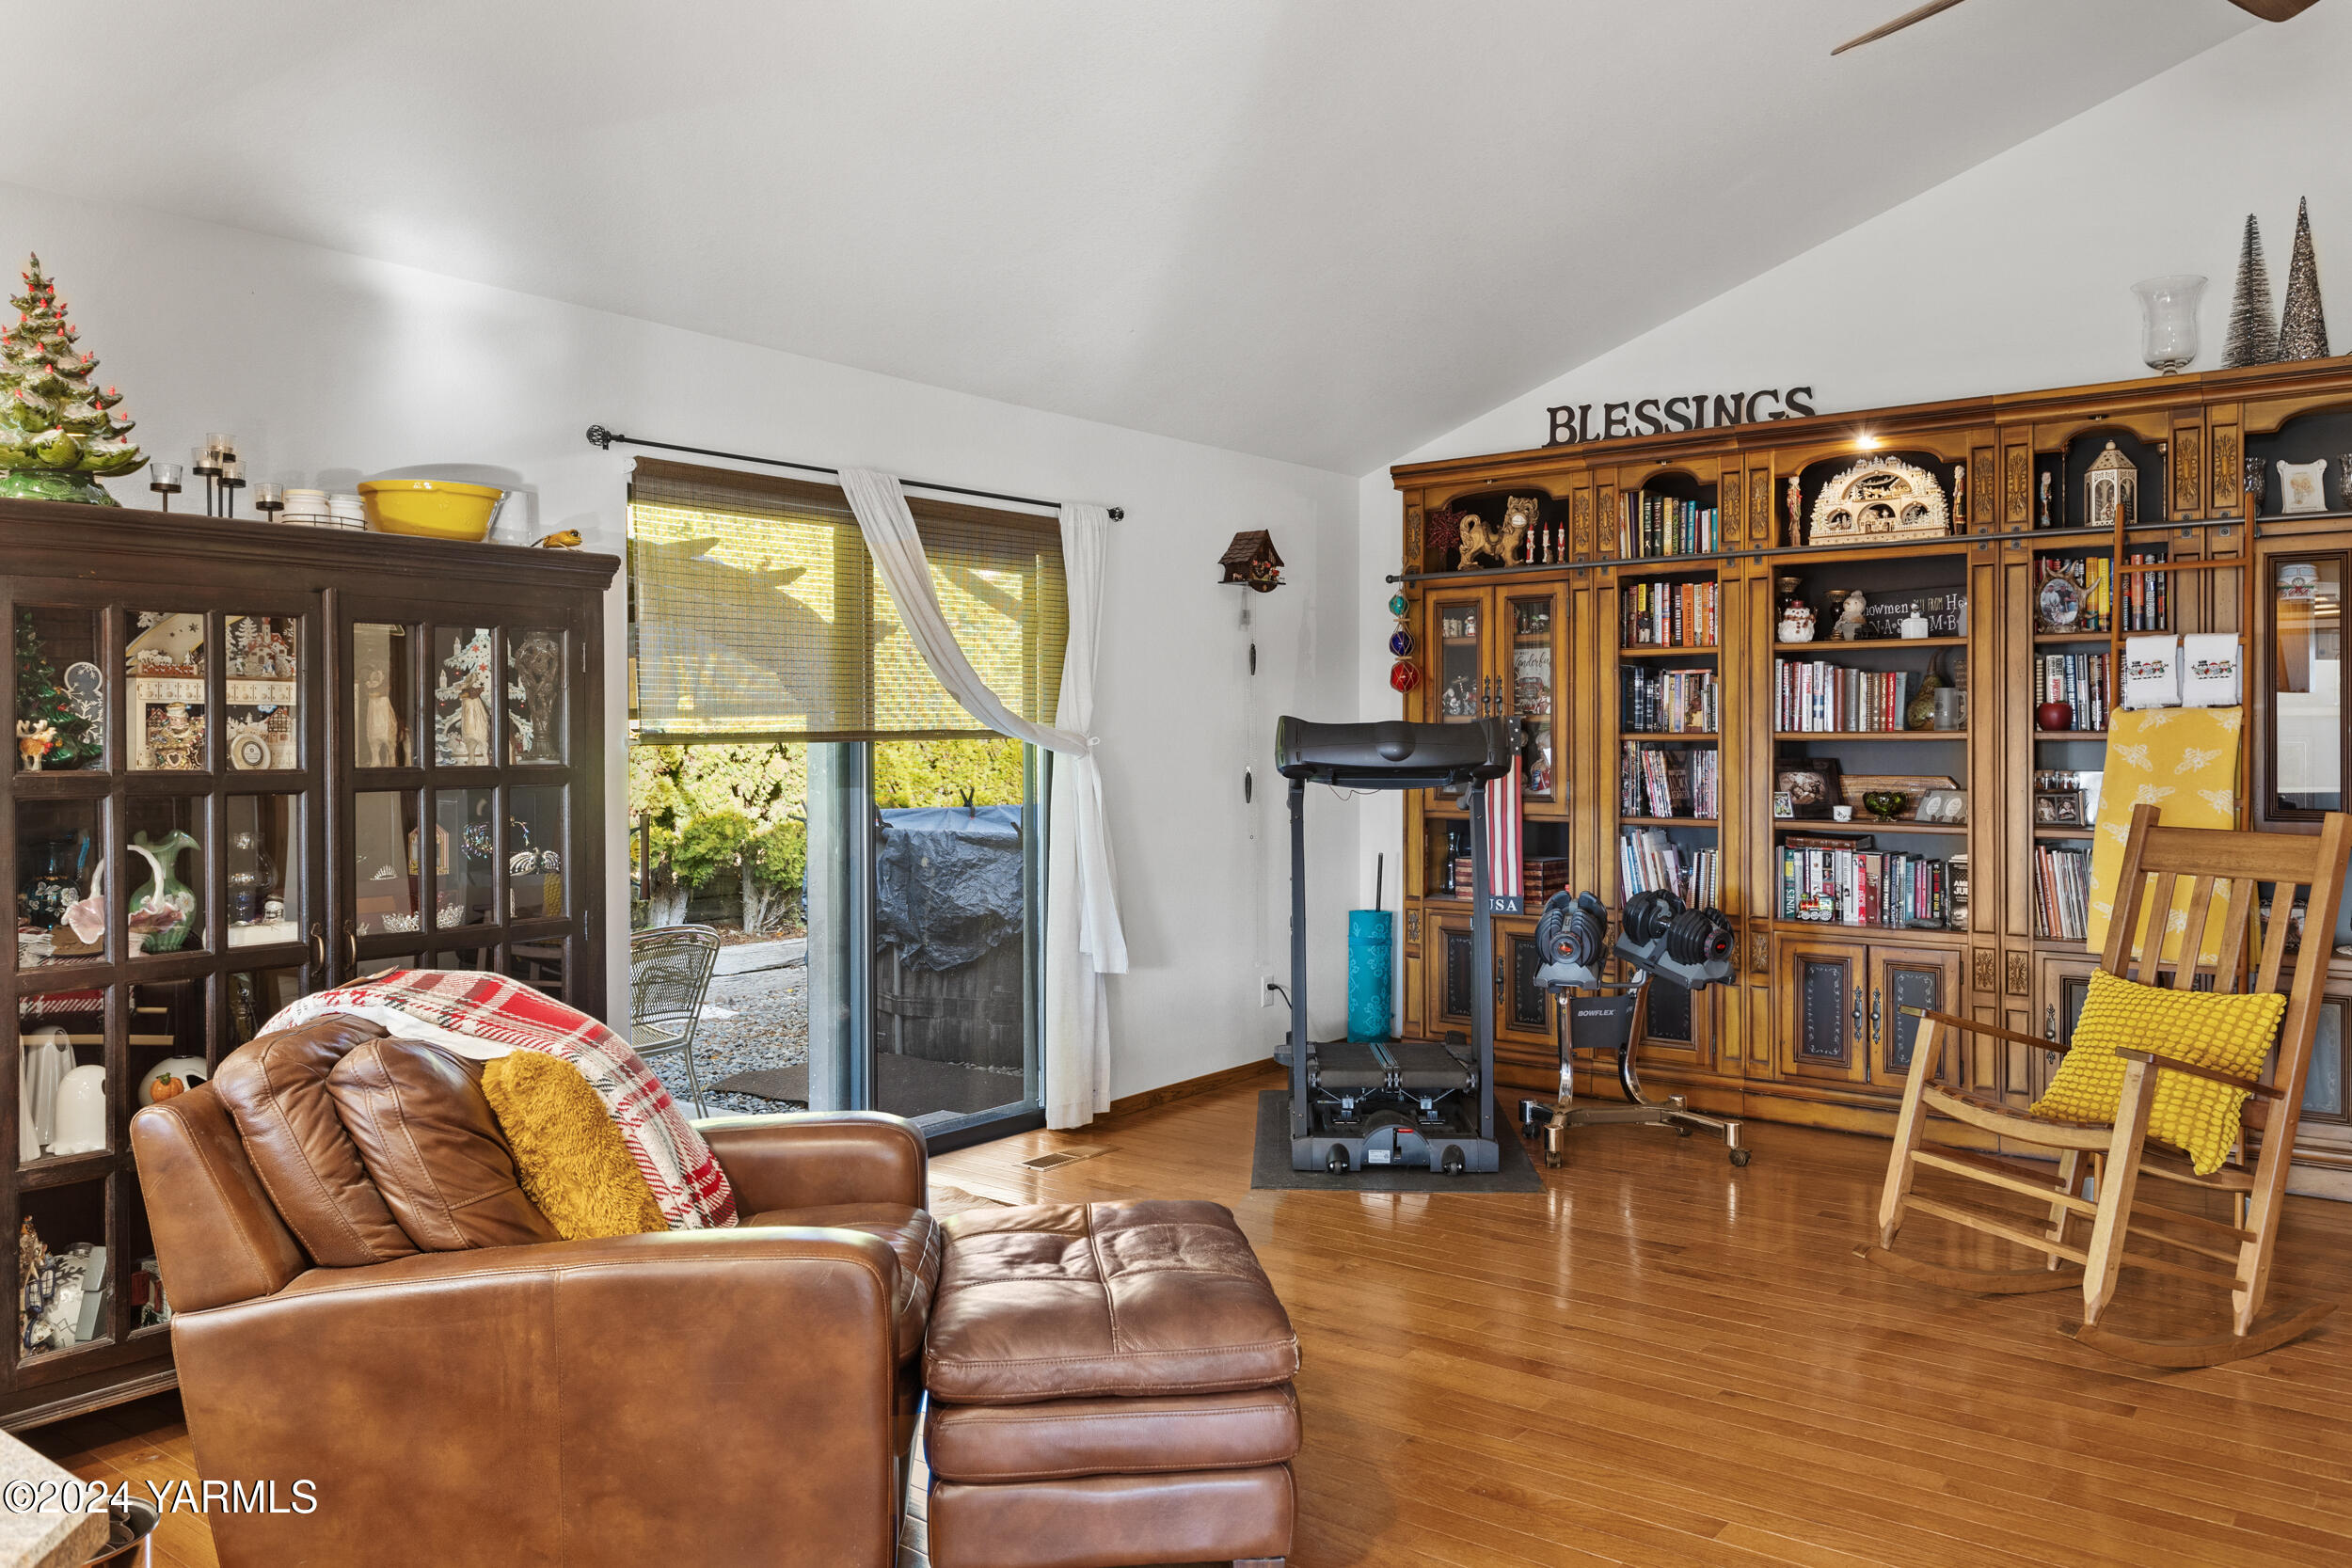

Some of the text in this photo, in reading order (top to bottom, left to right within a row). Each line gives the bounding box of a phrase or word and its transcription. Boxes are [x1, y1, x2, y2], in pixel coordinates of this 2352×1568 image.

[1543, 386, 1816, 447] BLESSINGS
[1866, 603, 1909, 616] nowmen
[1786, 889, 1795, 914] VINES
